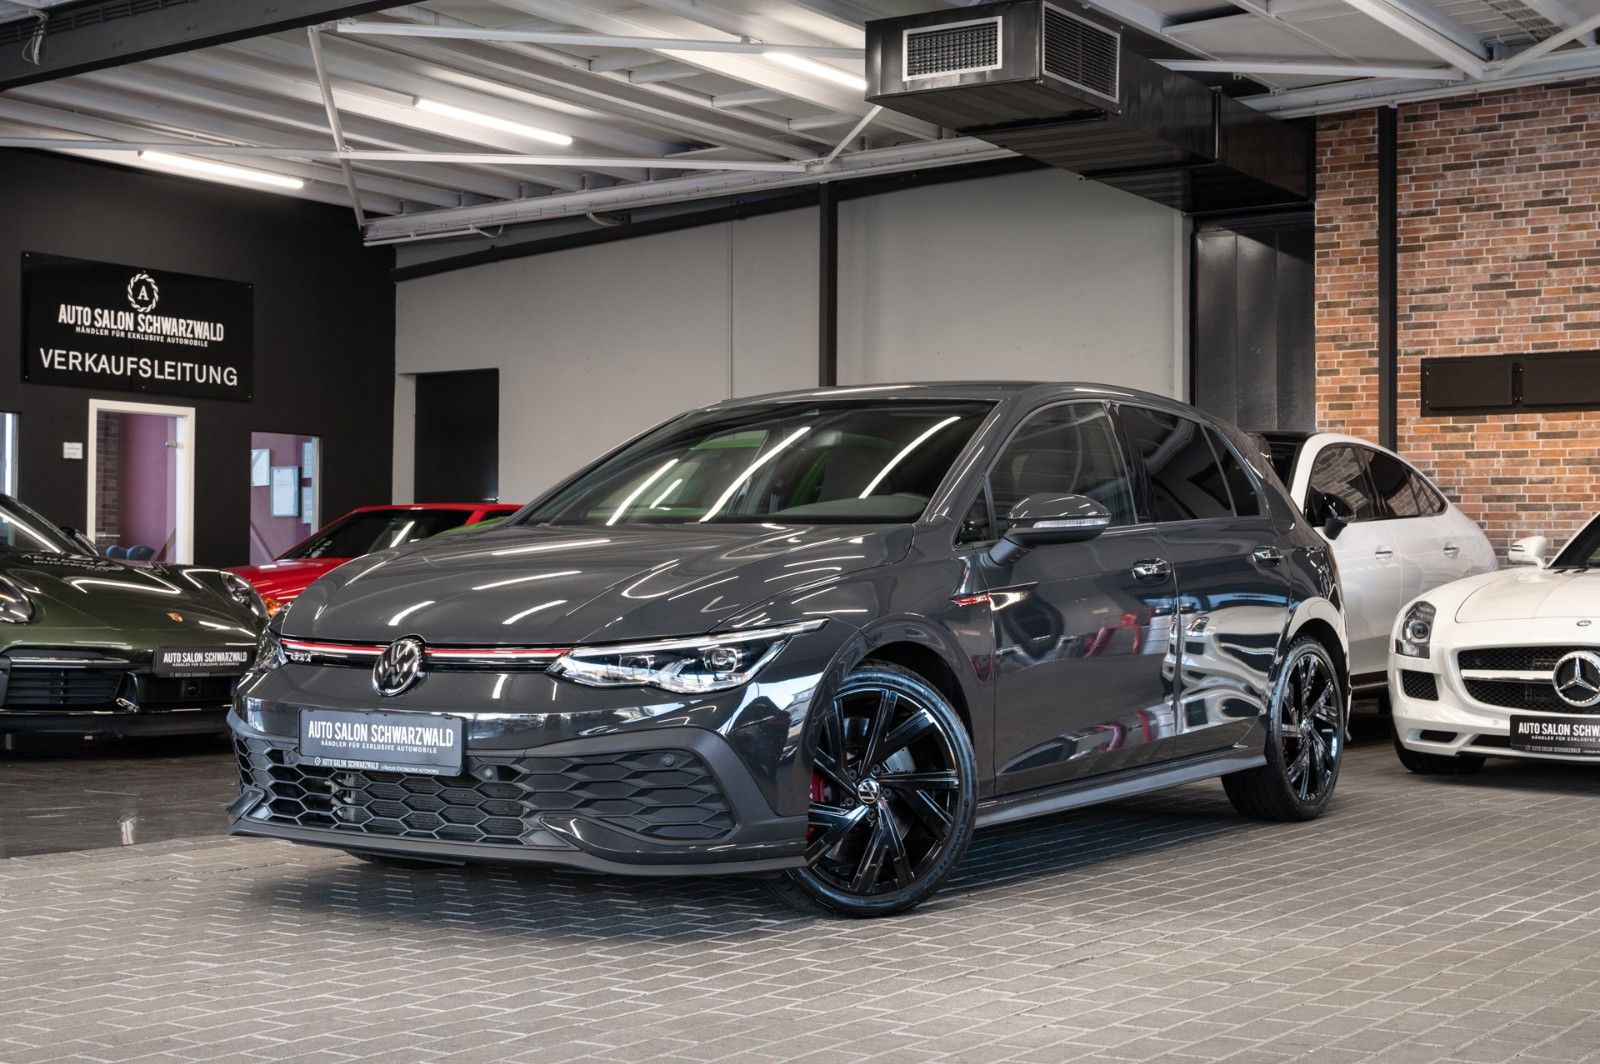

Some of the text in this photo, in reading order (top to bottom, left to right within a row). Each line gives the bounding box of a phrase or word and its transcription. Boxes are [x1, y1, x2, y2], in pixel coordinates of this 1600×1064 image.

[138, 285, 149, 301] A
[58, 304, 224, 342] AUTO SALON SCHWARZWALD
[111, 329, 125, 338] FÜR
[127, 332, 164, 343] EXKLUSIVE
[166, 337, 208, 348] AUTOMOBILE
[39, 348, 238, 386] VERKAUFSLEITUNG
[163, 651, 248, 663] AUTO SALON SCHWARZWALD
[308, 721, 454, 747] AUTO SALON SCHWARZWALD
[1518, 722, 1600, 737] AUTO SALON SCHW
[362, 742, 395, 751] EXKLUSIVE
[396, 744, 437, 753] AUTOMOBILE
